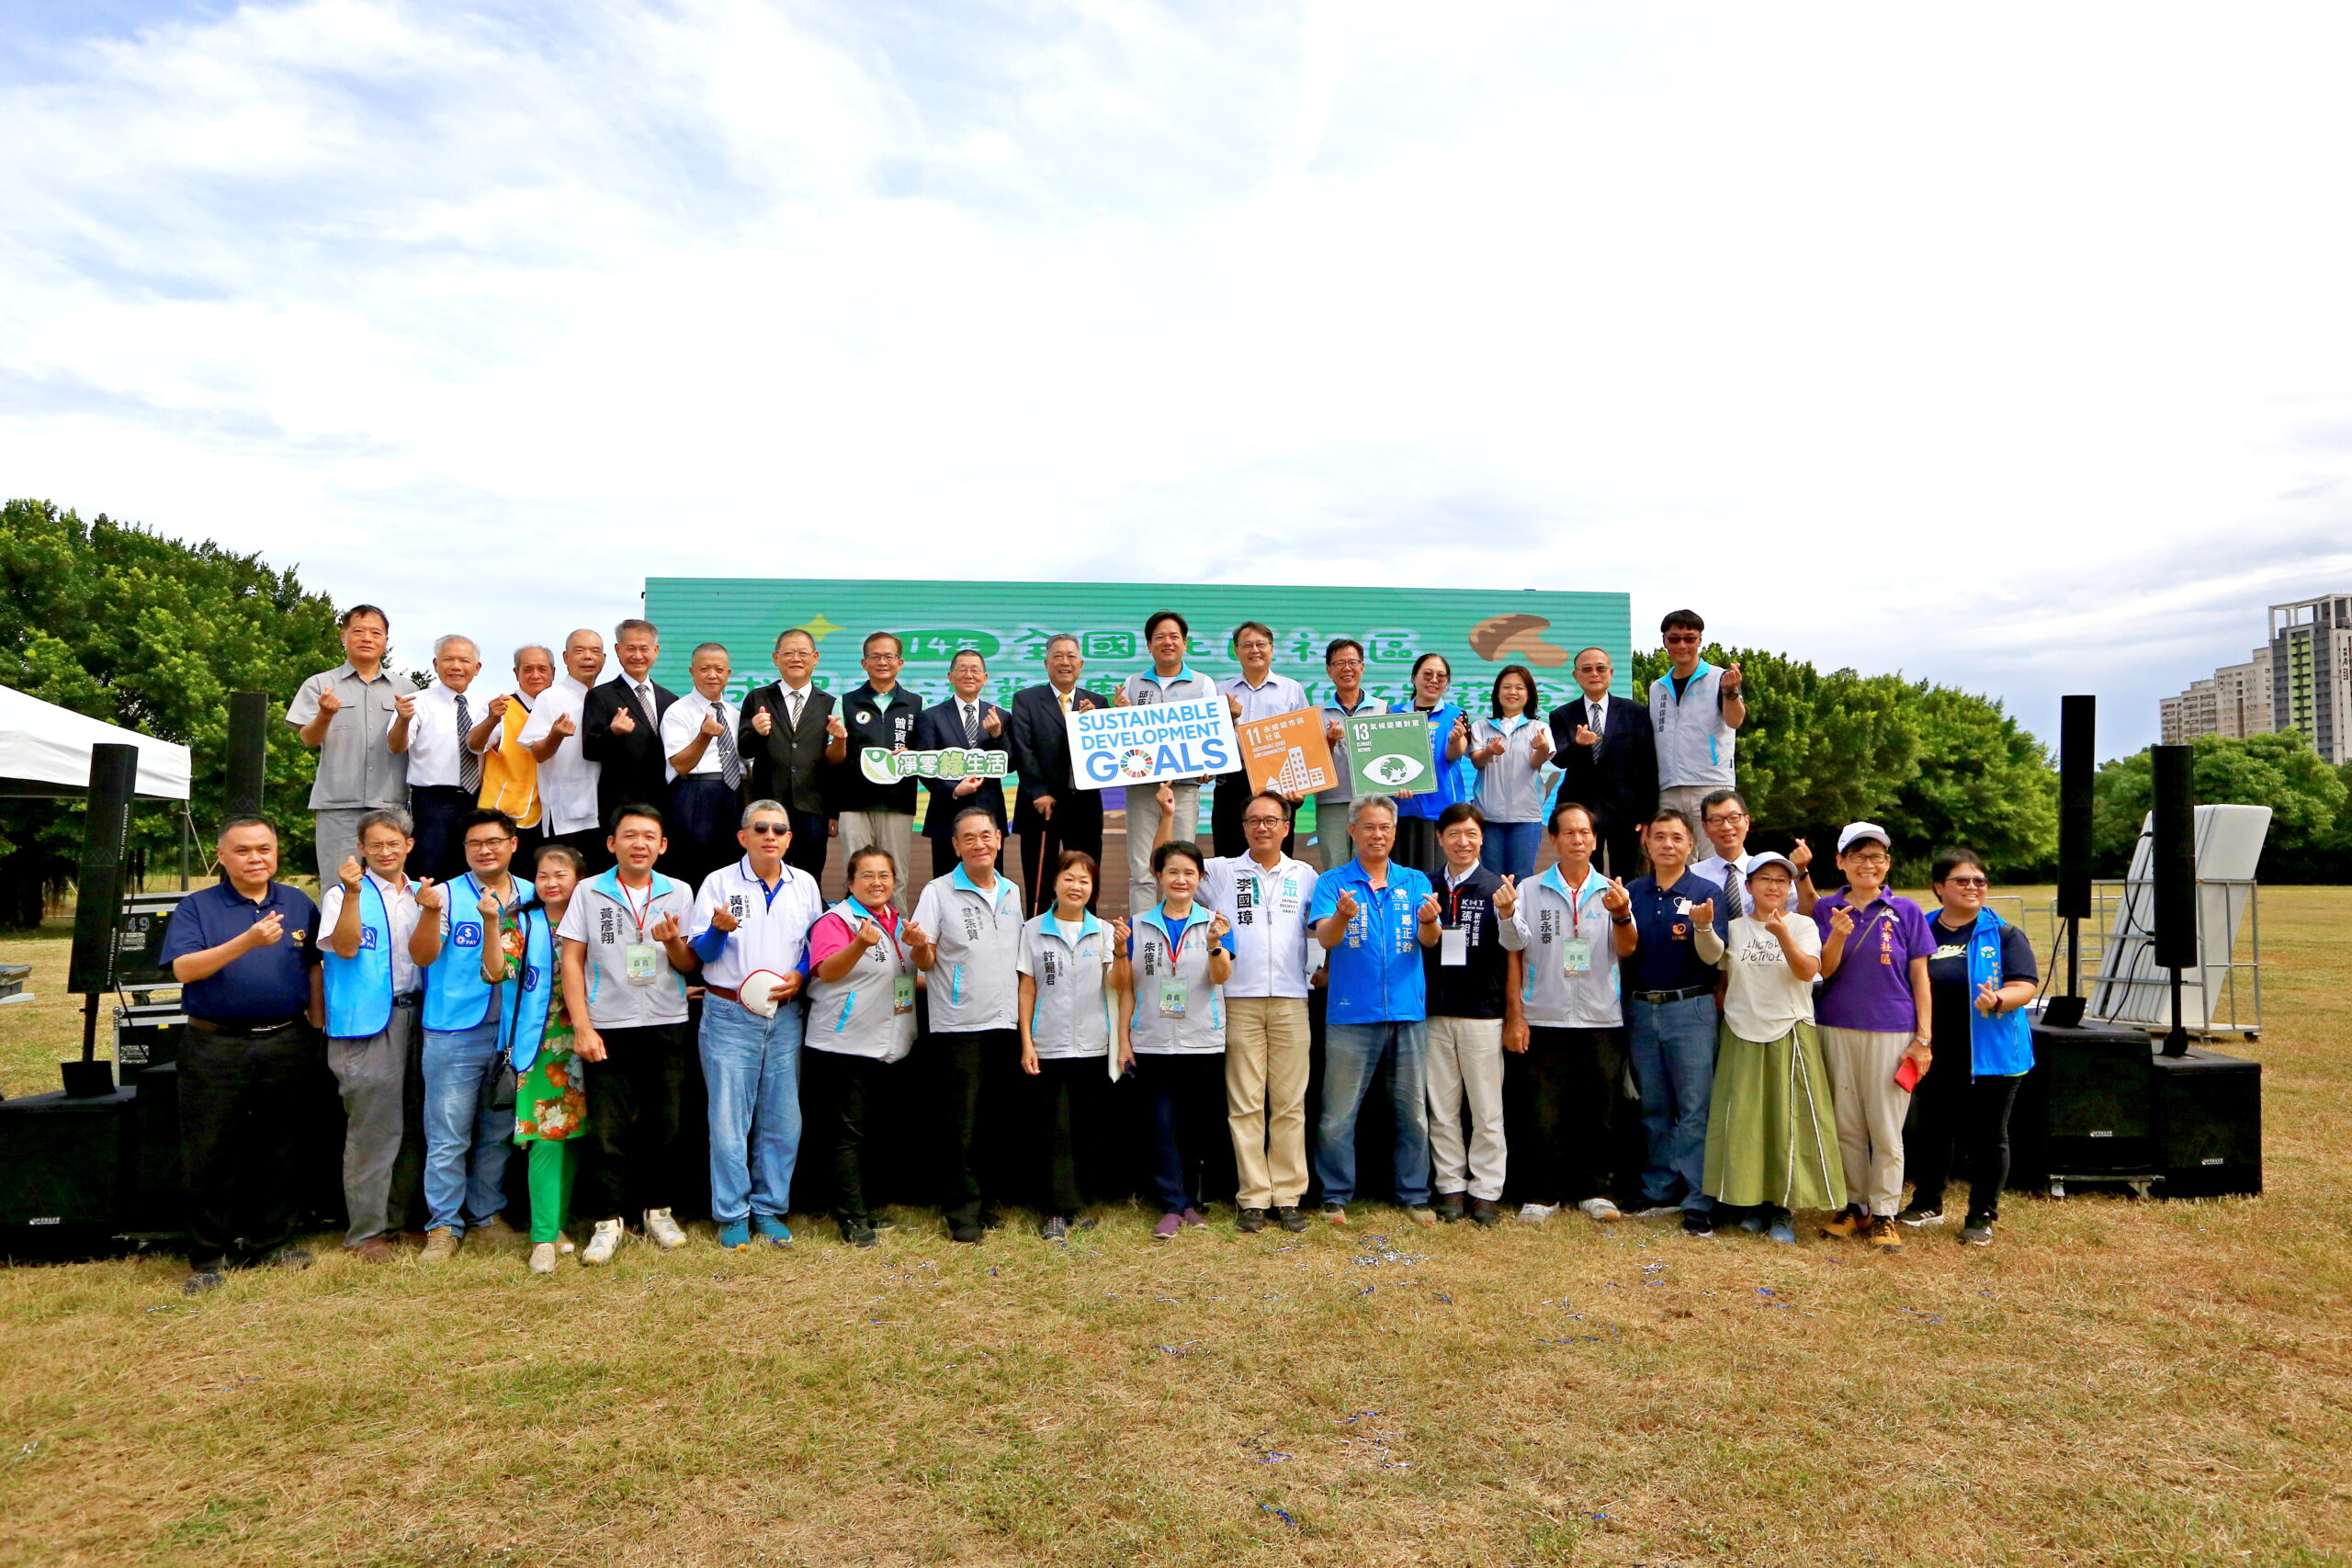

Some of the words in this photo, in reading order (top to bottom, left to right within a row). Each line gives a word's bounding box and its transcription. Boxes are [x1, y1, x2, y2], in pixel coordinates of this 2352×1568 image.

[1078, 702, 1219, 731] SUSTAINABLE
[1370, 719, 1419, 730] 氣候變遷對策
[1081, 721, 1220, 750] DEVELOPMENT
[1246, 727, 1262, 746] 11
[1265, 731, 1282, 741] 社區
[1352, 723, 1370, 741] 13
[898, 750, 1006, 778] 淨零綠生活
[1086, 739, 1228, 782] GOALS
[1237, 878, 1253, 925] 李國璋
[600, 908, 614, 944] 黃彥翔
[1540, 909, 1552, 944] 彭永泰
